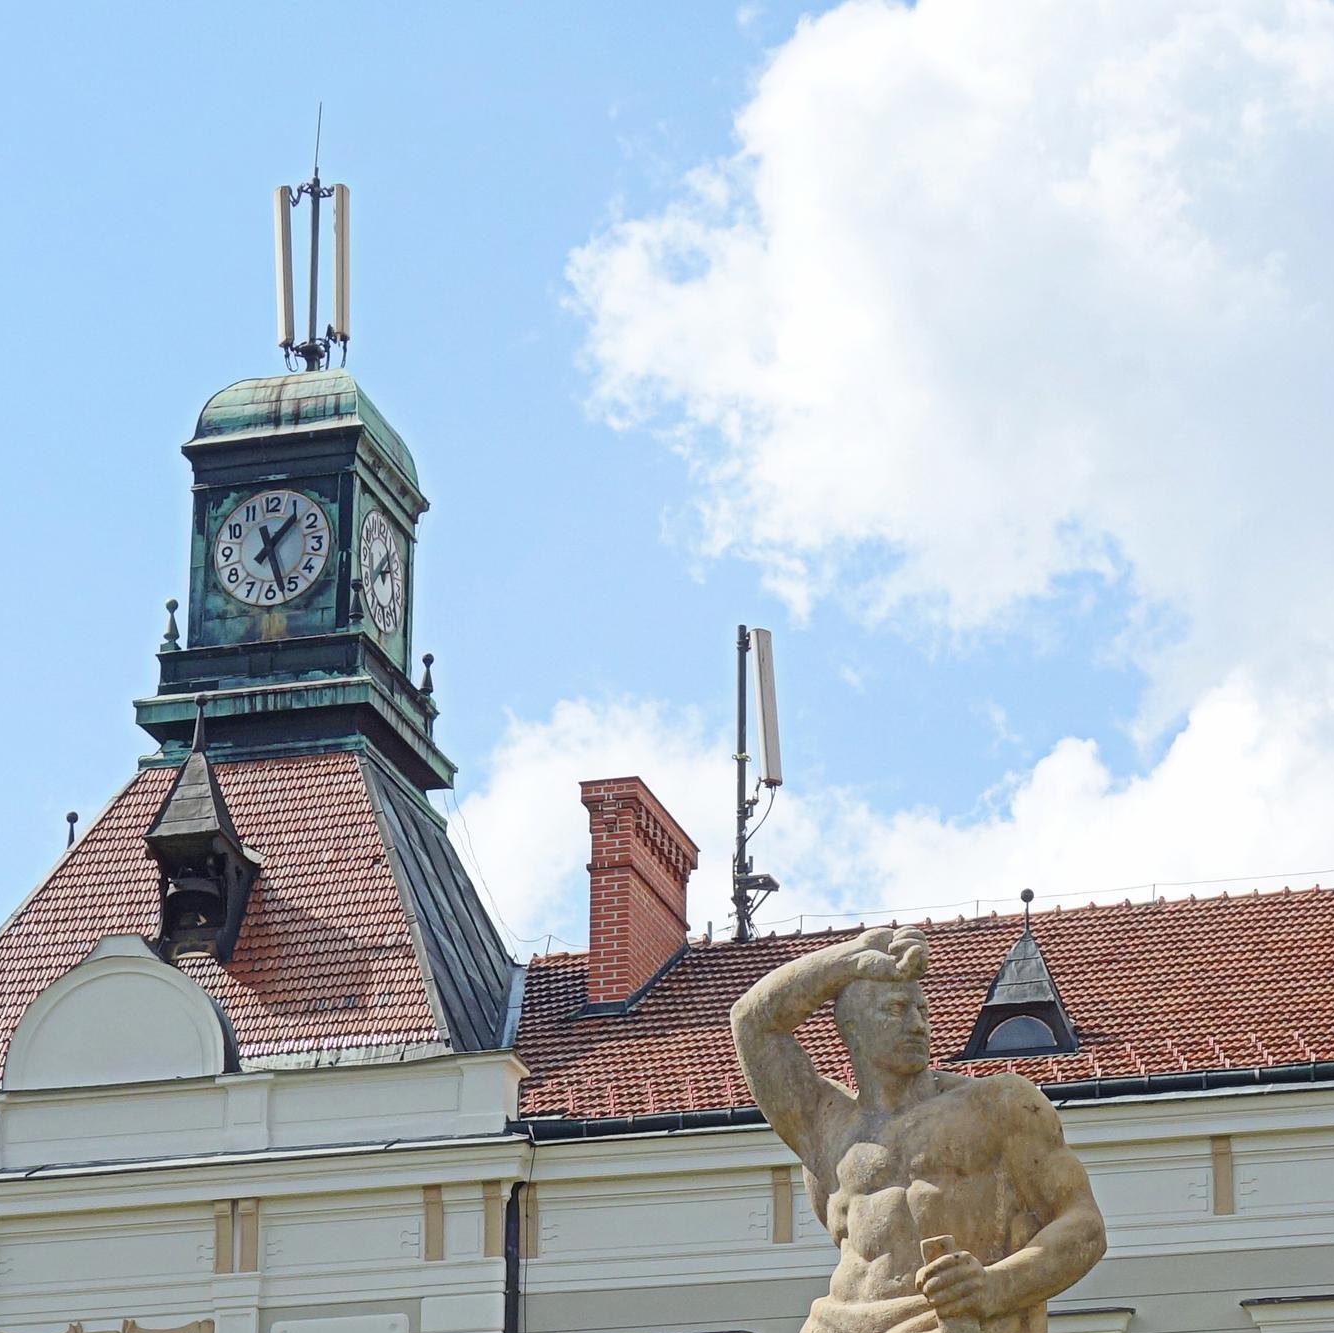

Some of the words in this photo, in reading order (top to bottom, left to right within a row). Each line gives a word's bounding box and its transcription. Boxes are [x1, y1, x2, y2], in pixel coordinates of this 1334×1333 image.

[246, 505, 256, 521] 11
[267, 497, 282, 513] 12
[306, 513, 318, 529] 2
[229, 523, 242, 539] 10
[311, 536, 323, 552] 3
[222, 546, 233, 562] 9
[302, 558, 315, 574] 4
[228, 568, 239, 584] 8
[287, 576, 299, 592] 5
[245, 581, 256, 598] 7
[265, 584, 276, 600] 6
